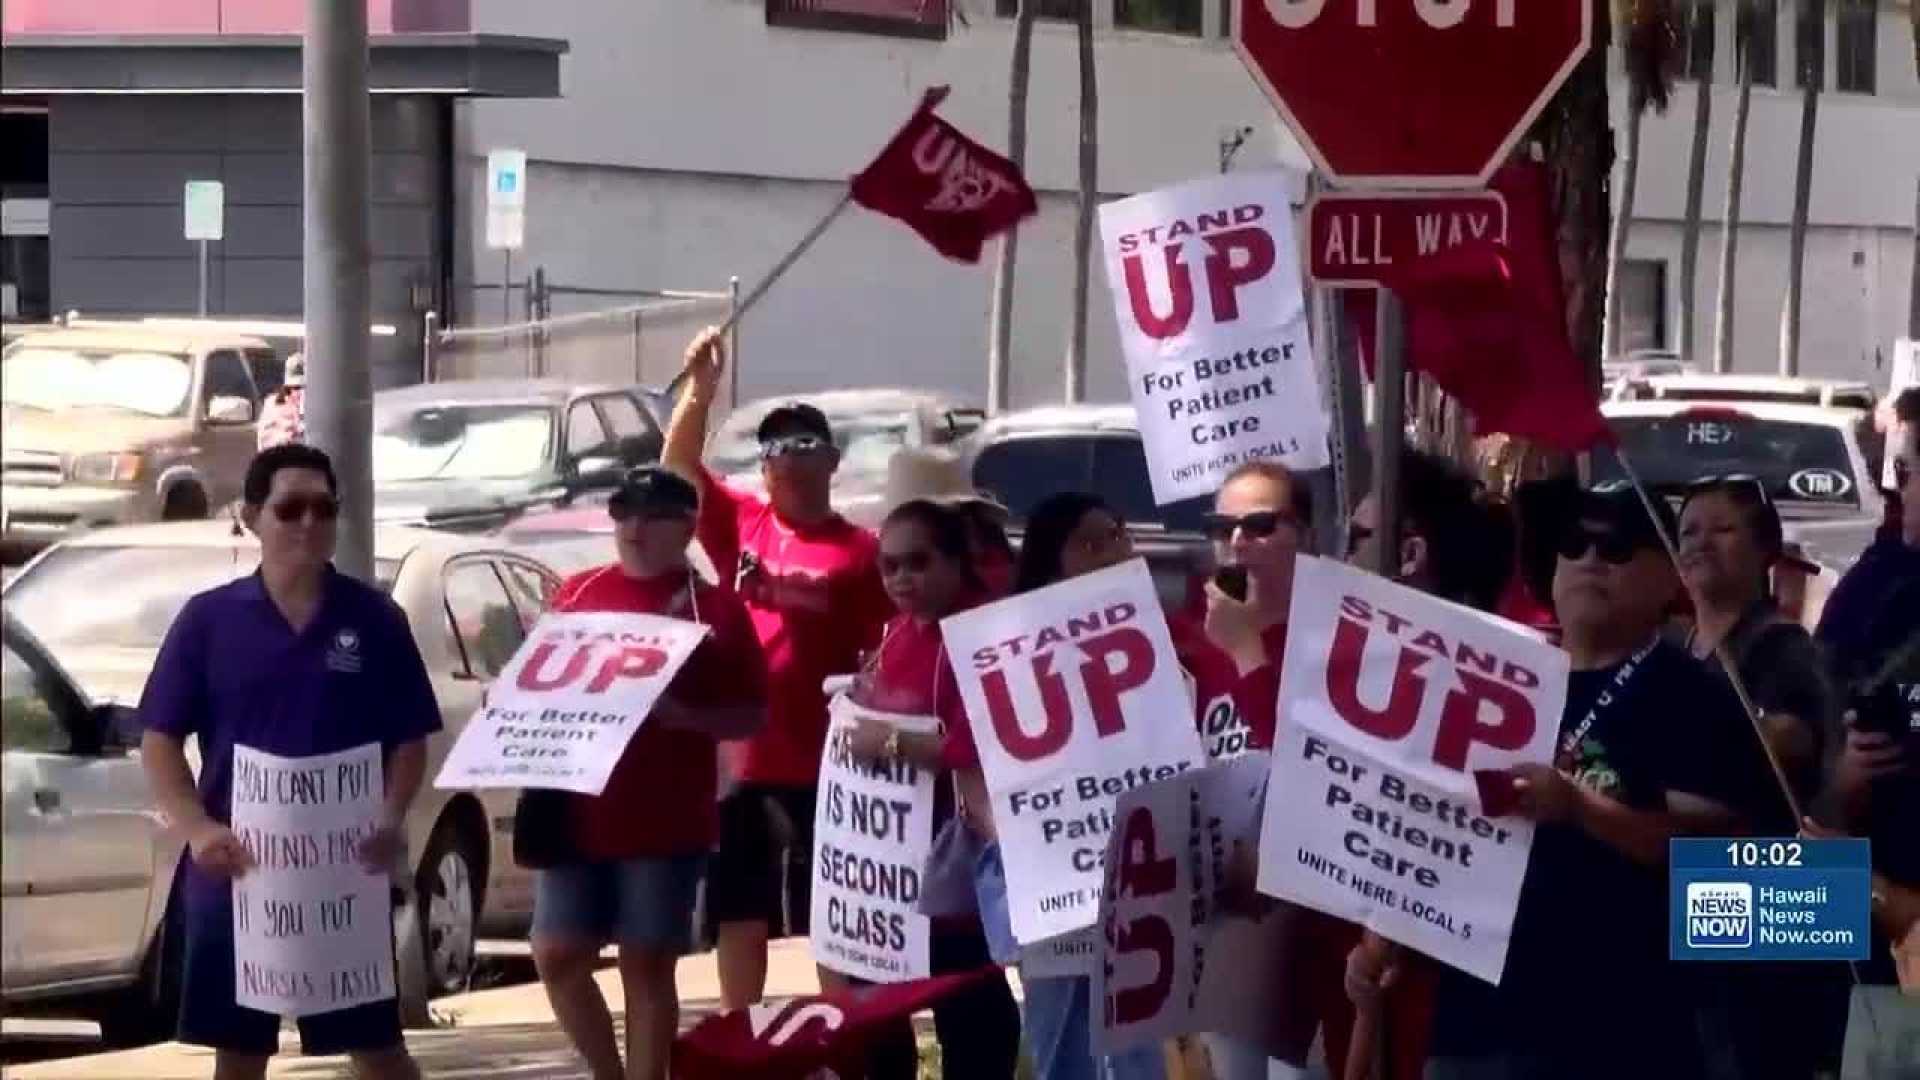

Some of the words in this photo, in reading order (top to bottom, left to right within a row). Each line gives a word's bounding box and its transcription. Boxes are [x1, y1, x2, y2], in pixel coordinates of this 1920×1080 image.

[1119, 204, 1264, 252] STAND
[1325, 215, 1392, 265] ALL
[1123, 227, 1276, 340] UP
[1143, 371, 1184, 396] For
[1194, 341, 1295, 380] Better
[1168, 376, 1275, 420] Patient
[1191, 414, 1261, 445] Care
[972, 602, 1138, 670] STAND
[1340, 595, 1540, 690] STAND
[516, 643, 669, 694] UP
[980, 626, 1156, 763] UP
[1326, 616, 1536, 772] UP
[486, 708, 528, 722] For
[539, 708, 628, 725] Better
[495, 725, 600, 742] Patient
[501, 744, 569, 758] Care
[236, 759, 269, 803] YOU
[277, 767, 326, 805] CANT
[338, 760, 371, 800] PUT
[1010, 787, 1066, 817] For
[1303, 738, 1369, 783] For
[1380, 772, 1513, 846] Better
[827, 780, 844, 826] IS
[851, 792, 913, 844] NOT
[1326, 784, 1474, 868] Patient
[820, 843, 920, 904] SECOND
[1343, 831, 1441, 889] Care
[264, 899, 304, 937] YOU
[321, 894, 357, 933] PUT
[1040, 890, 1084, 912] UNITE
[1116, 806, 1177, 1025] UP
[1297, 848, 1348, 887] UNITE
[1350, 873, 1399, 909] HERE
[1401, 894, 1457, 934] LOCAL
[1460, 923, 1473, 940] 5
[827, 896, 906, 951] CLASS
